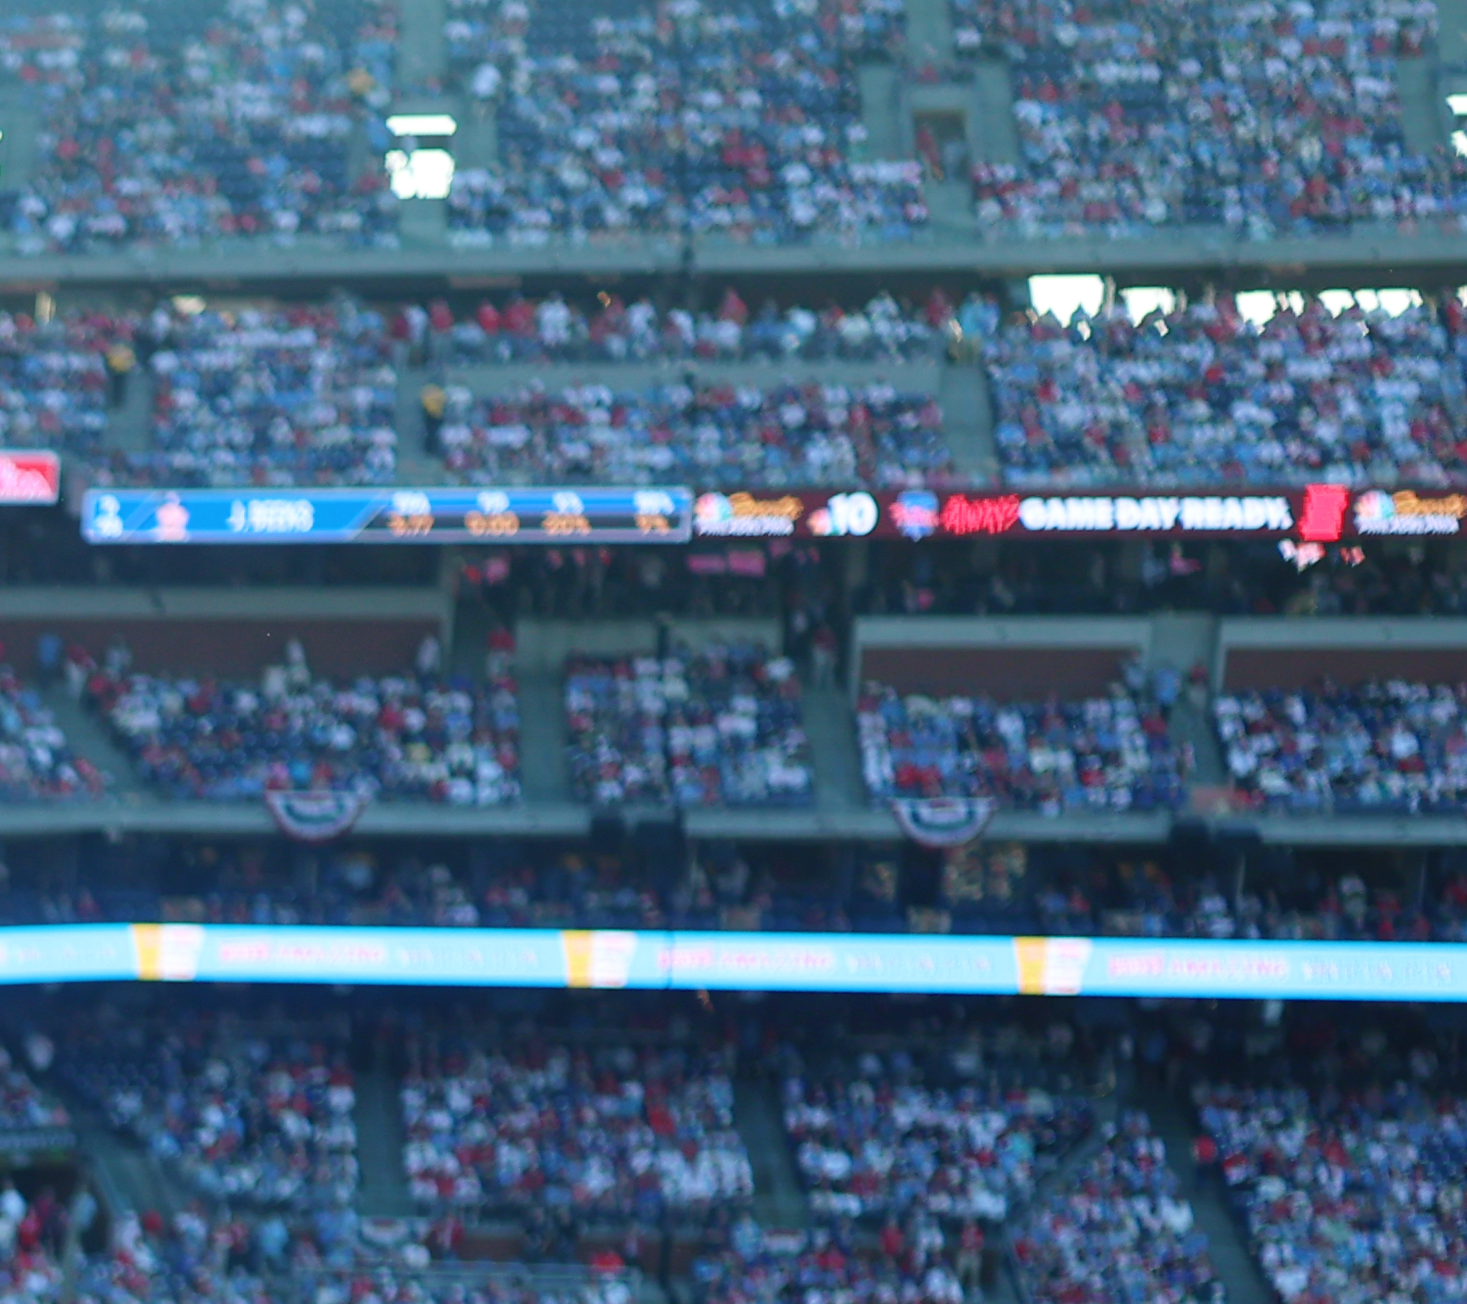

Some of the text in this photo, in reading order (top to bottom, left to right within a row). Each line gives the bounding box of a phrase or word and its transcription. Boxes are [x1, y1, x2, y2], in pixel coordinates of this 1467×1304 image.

[828, 491, 878, 536] 10
[1019, 496, 1113, 530] GAME
[1115, 496, 1180, 530] DAY
